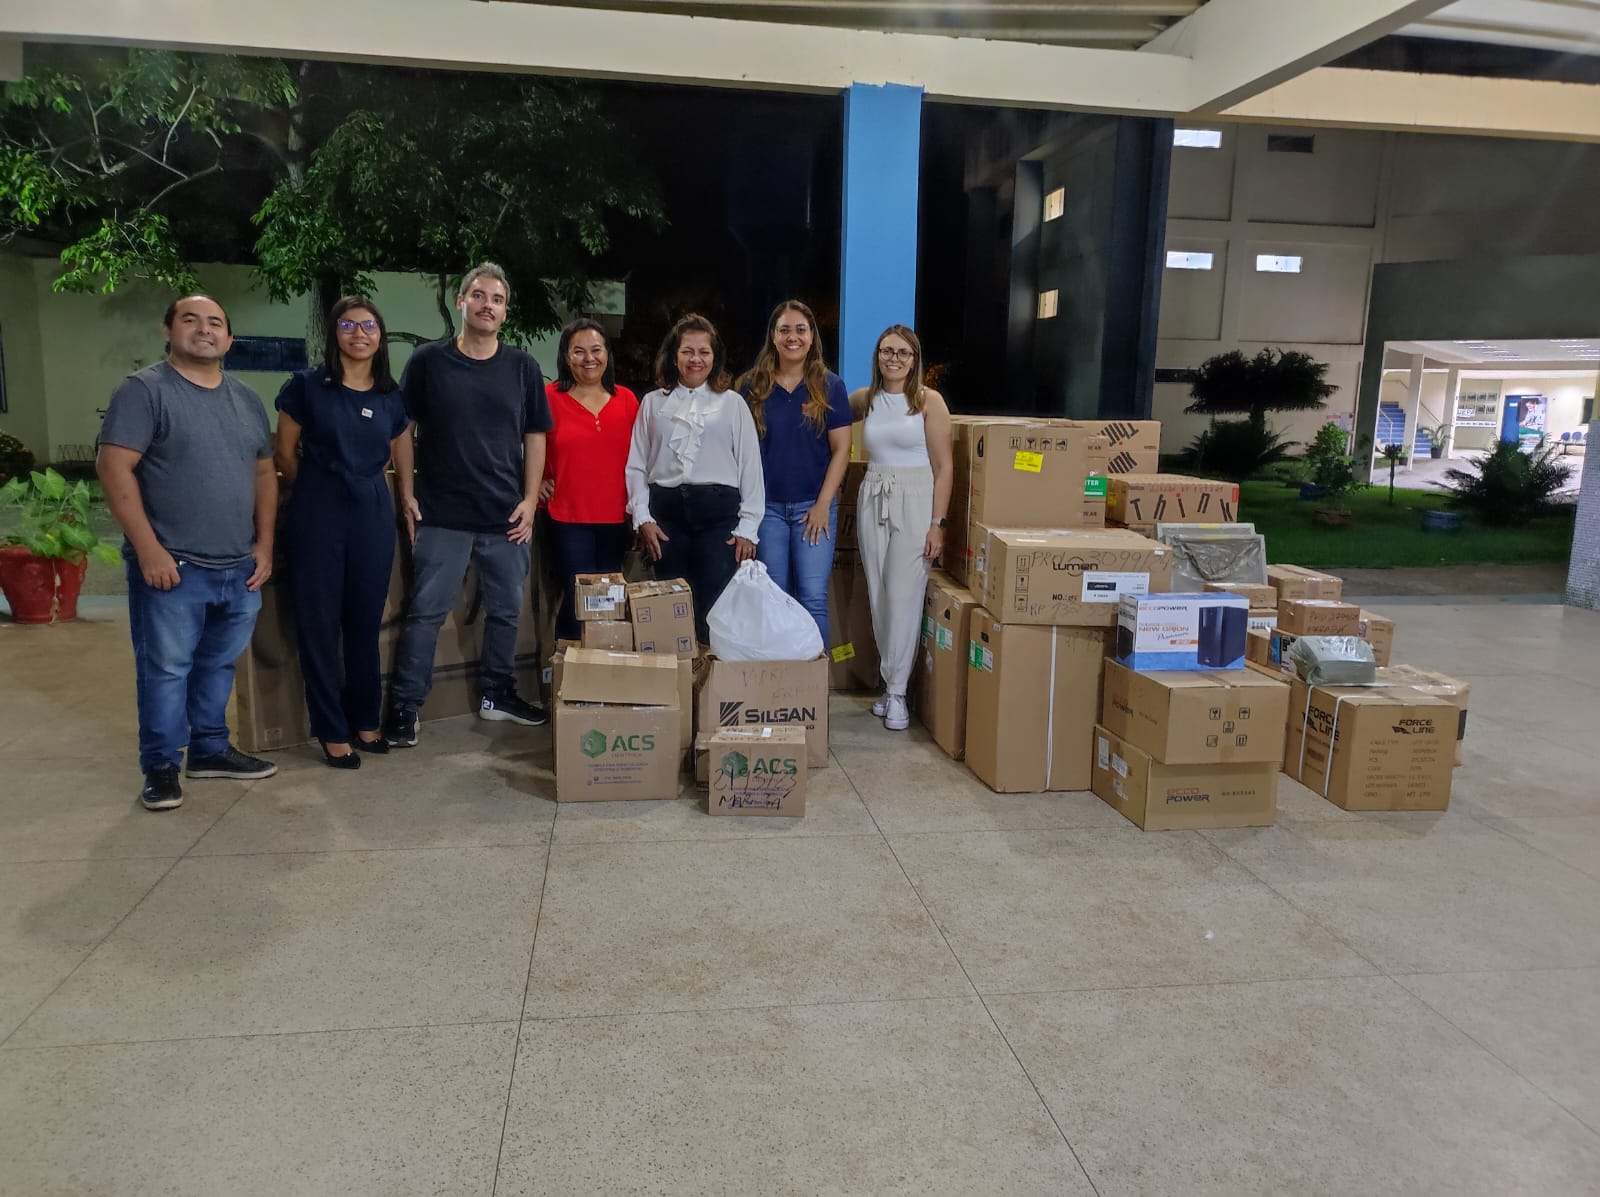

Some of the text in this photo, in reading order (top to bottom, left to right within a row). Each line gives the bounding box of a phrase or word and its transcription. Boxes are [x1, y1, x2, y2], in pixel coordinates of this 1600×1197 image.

[1129, 492, 1233, 522] Think
[745, 706, 816, 723] SILGAN
[611, 734, 655, 752] ACS
[752, 758, 797, 775] ACS
[1166, 794, 1210, 804] POWER
